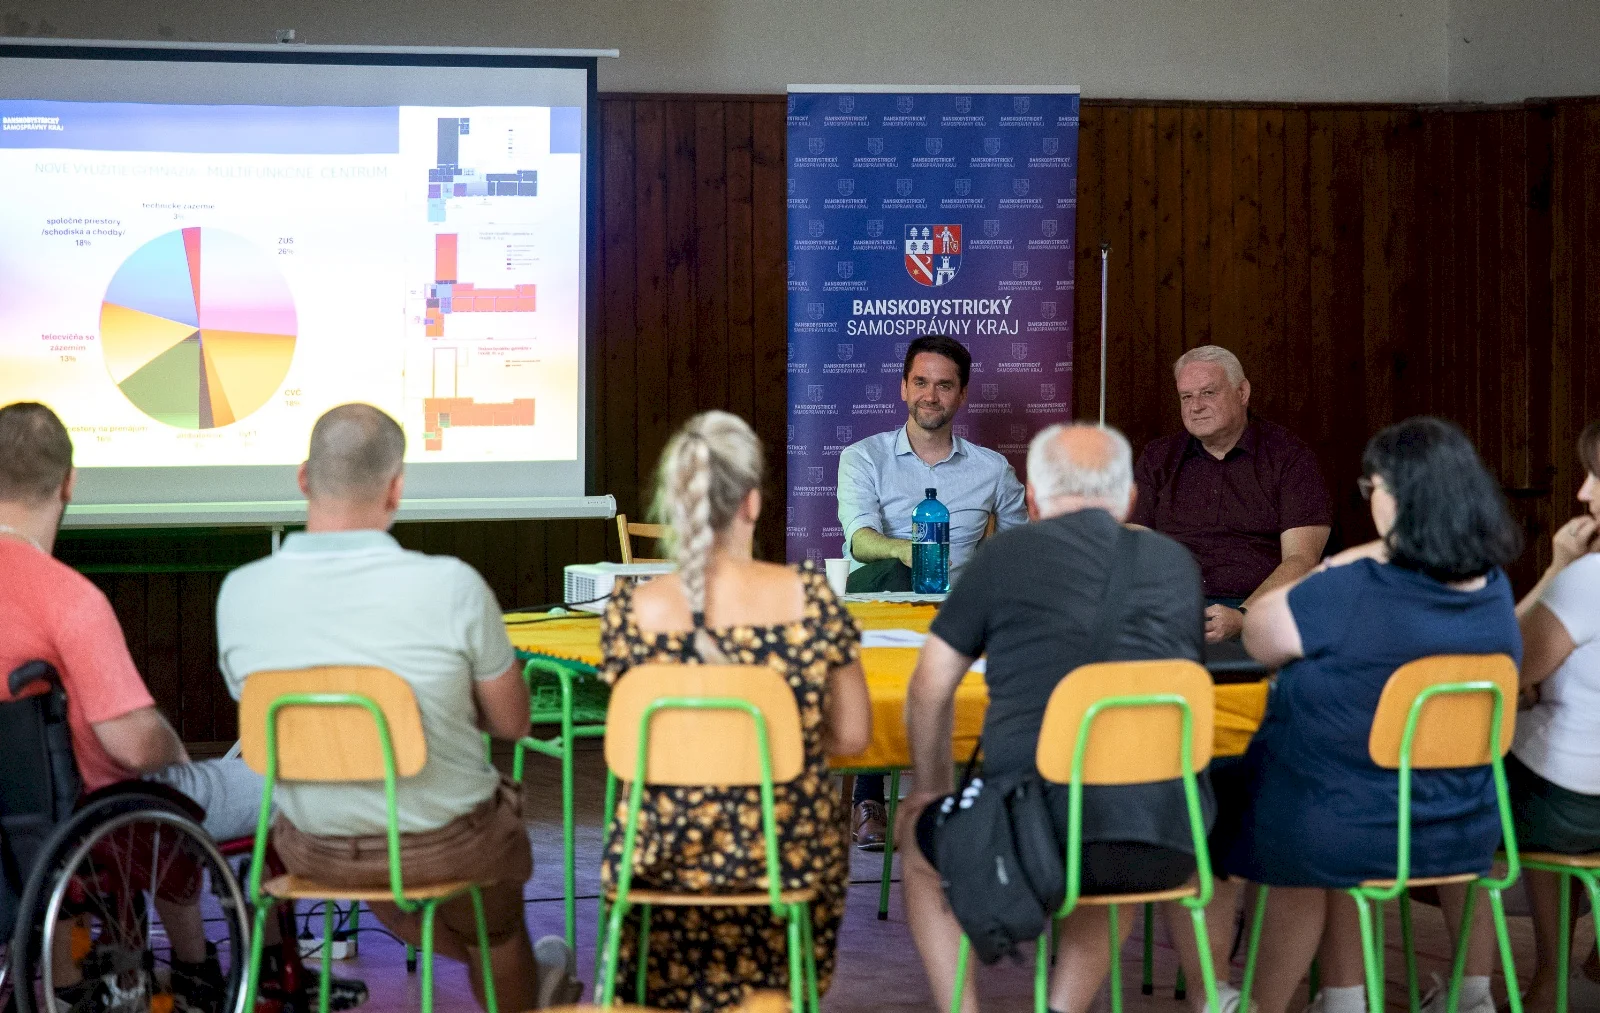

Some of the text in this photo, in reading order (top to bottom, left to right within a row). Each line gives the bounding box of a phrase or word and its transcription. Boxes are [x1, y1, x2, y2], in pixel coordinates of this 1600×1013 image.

[84, 218, 120, 226] priestory
[853, 296, 1013, 315] BANSKOBYSTRICKÝ
[846, 316, 1019, 336] SAMOSPRÁVNY KRAJ
